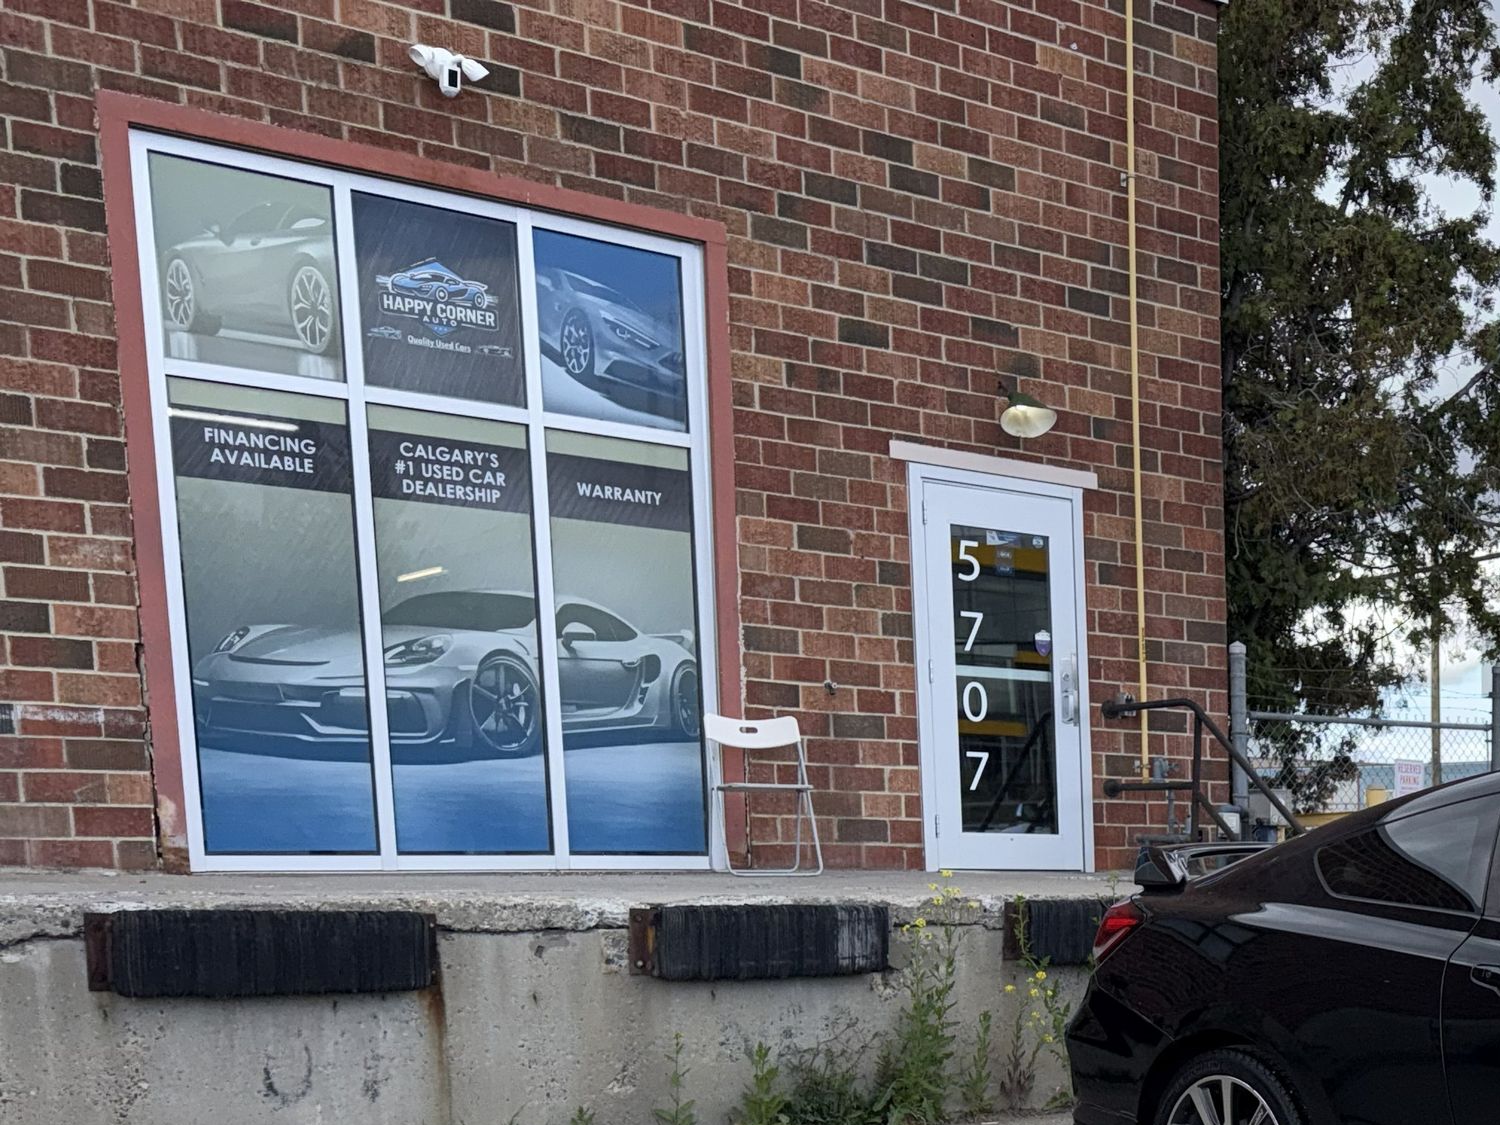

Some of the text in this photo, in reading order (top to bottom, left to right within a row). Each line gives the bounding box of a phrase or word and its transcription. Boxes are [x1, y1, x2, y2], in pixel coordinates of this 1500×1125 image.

[383, 293, 495, 327] HAPPY CORNER
[422, 315, 457, 327] AUTO
[407, 334, 471, 354] Quality Used Cars
[204, 427, 316, 455] FINANCING
[210, 447, 314, 474] AVAILABLE
[399, 442, 500, 468] CALGARY'S
[394, 459, 506, 487] #1 USED CAR
[402, 479, 501, 504] DEALERSHIP
[576, 481, 662, 506] WARRANTY
